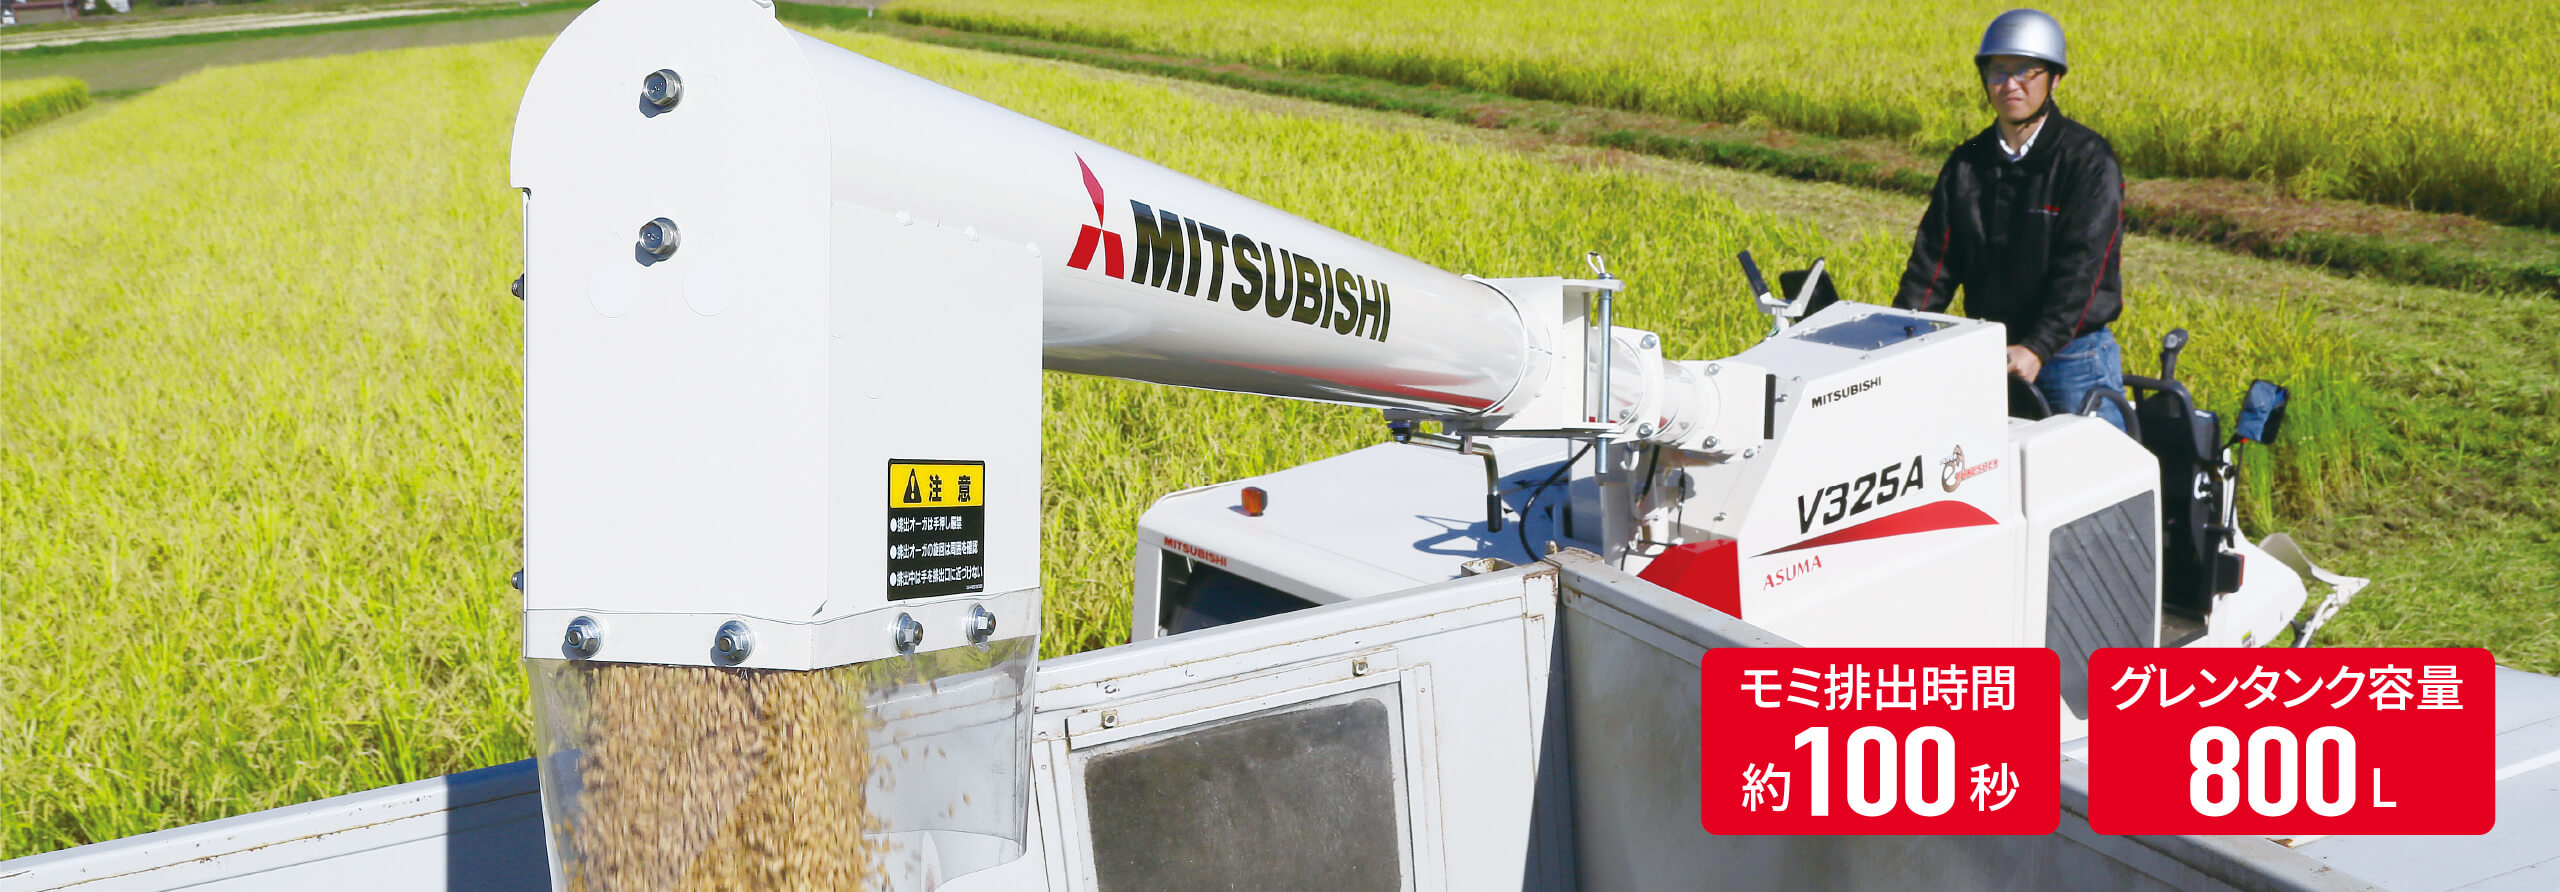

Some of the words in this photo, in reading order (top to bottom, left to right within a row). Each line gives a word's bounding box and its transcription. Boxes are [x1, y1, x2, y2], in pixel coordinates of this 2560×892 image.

[1129, 199, 1391, 343] MITSUBISHI
[1811, 376, 1882, 409] MITSUBISHI
[929, 474, 972, 503] 注意
[1797, 455, 1924, 534] V325A
[1164, 536, 1228, 567] MITSUBISHI
[1763, 554, 1823, 591] ASUMA
